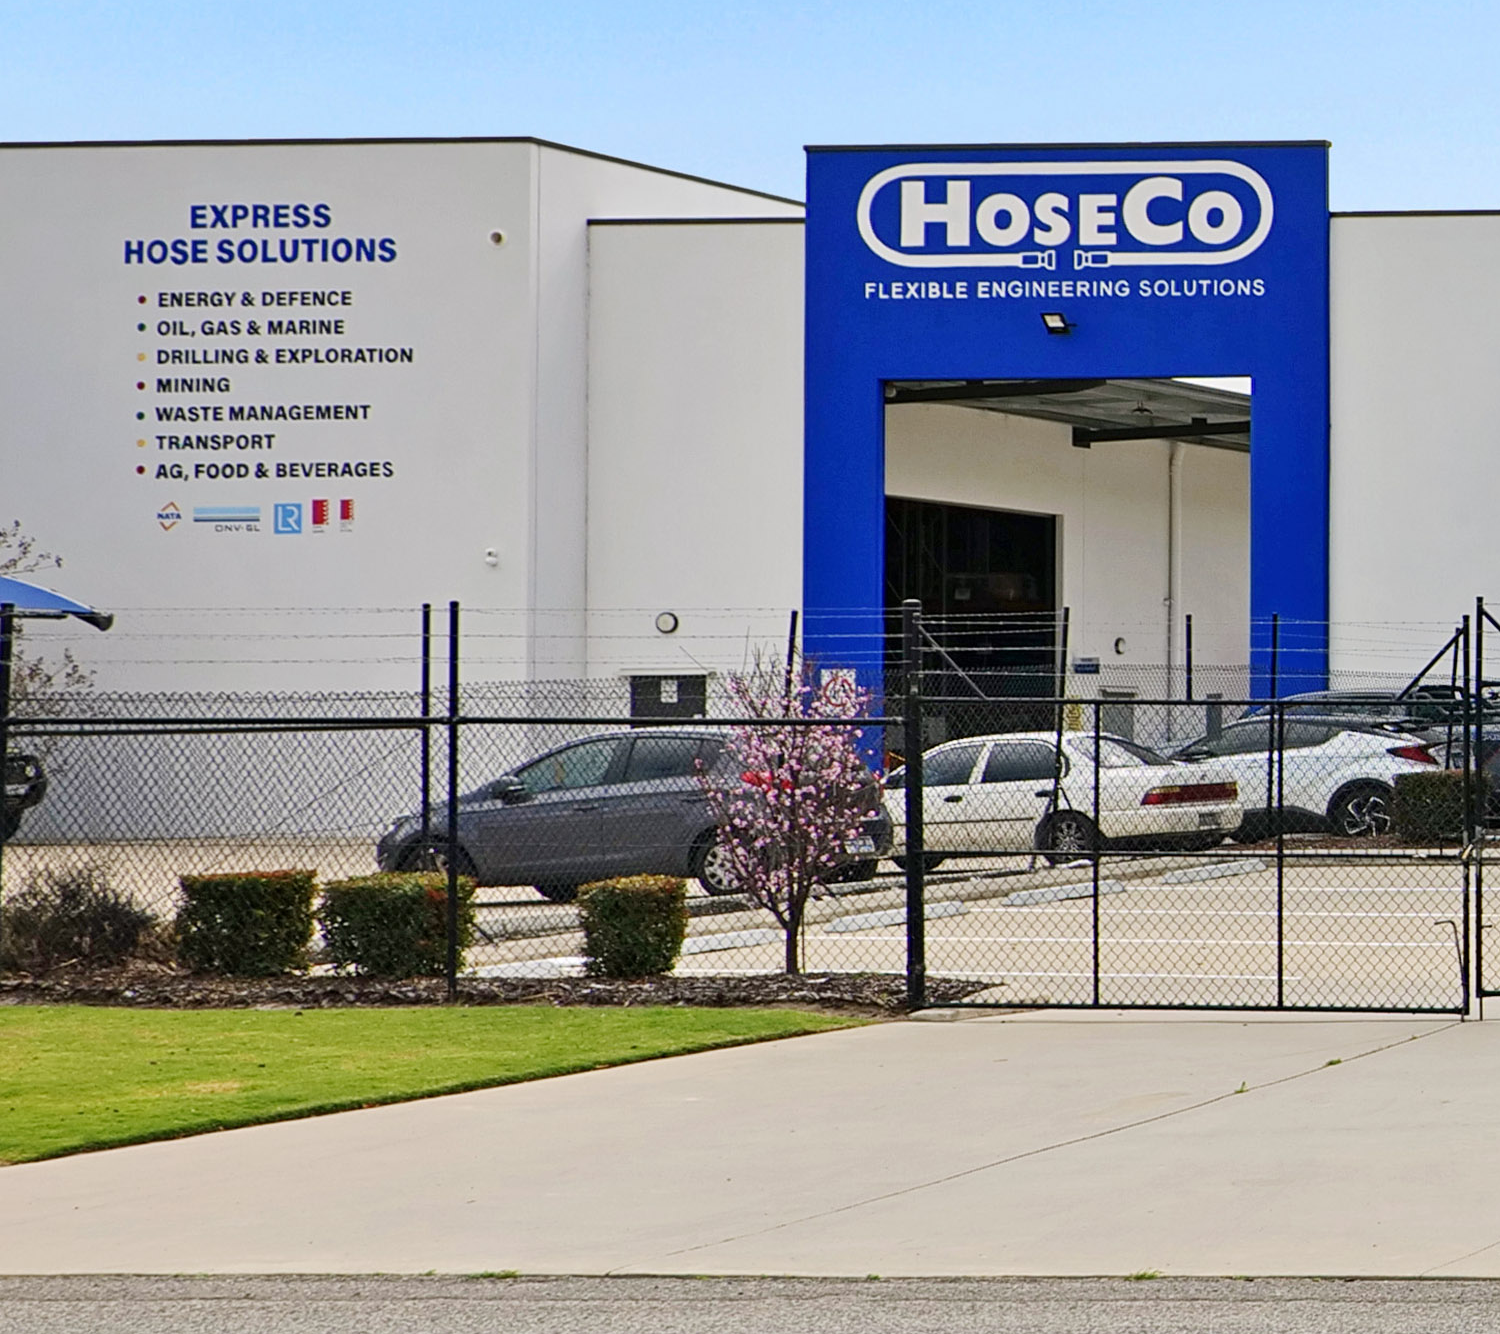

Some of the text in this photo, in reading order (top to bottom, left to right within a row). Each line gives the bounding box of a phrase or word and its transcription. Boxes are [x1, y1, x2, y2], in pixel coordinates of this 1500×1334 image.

[190, 204, 332, 229] EXPRESS
[124, 237, 397, 265] HOSE SOLUTIONS
[864, 278, 1266, 299] FLEXIBLE ENGINEERING SOLUTIONS
[158, 291, 352, 307] ENERGY & DEFENCE
[157, 319, 345, 337] OIL, GAS & MARINE
[156, 348, 413, 364] DRILLING & EXPLORATION
[156, 377, 230, 393] MINING
[156, 405, 371, 422] WASTE MANAGEMENT
[156, 434, 275, 450] TRANSPORT
[155, 462, 394, 481] AG, FOOD & BEVERAGES
